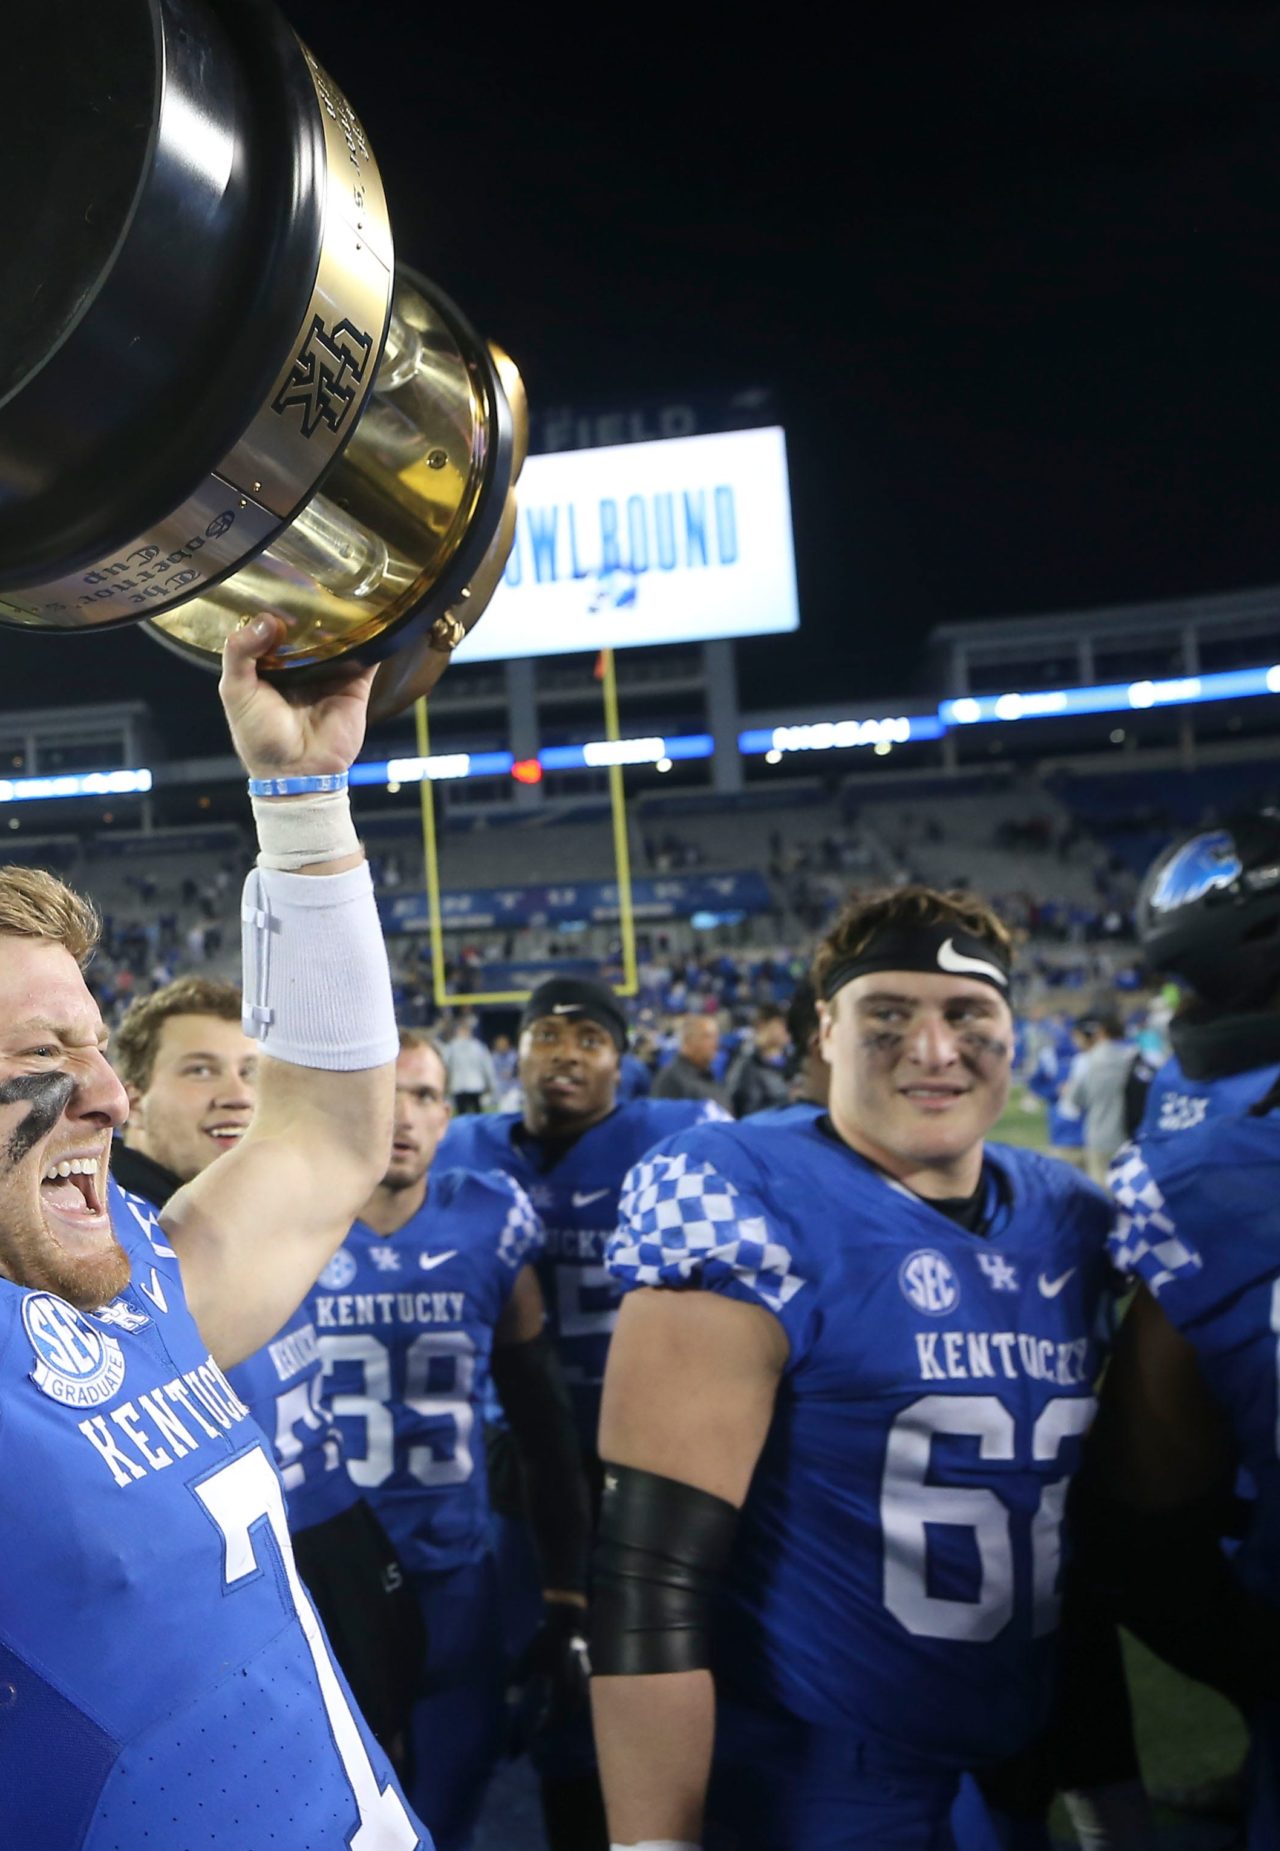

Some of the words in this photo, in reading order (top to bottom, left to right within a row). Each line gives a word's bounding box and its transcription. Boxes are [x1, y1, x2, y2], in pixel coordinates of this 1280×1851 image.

[503, 502, 588, 586] OWL
[597, 483, 739, 574] BOUND
[82, 544, 160, 585] Cup
[127, 568, 201, 604] The
[316, 1293, 465, 1327] KENTUCKY
[906, 1254, 956, 1311] SEC
[28, 1296, 102, 1375] SEC
[915, 1331, 1088, 1386] KENTUCKY
[51, 1354, 124, 1405] GRADUATE
[78, 1354, 250, 1488] KENTUCK
[318, 1331, 474, 1488] 39
[194, 1443, 420, 1851] 7
